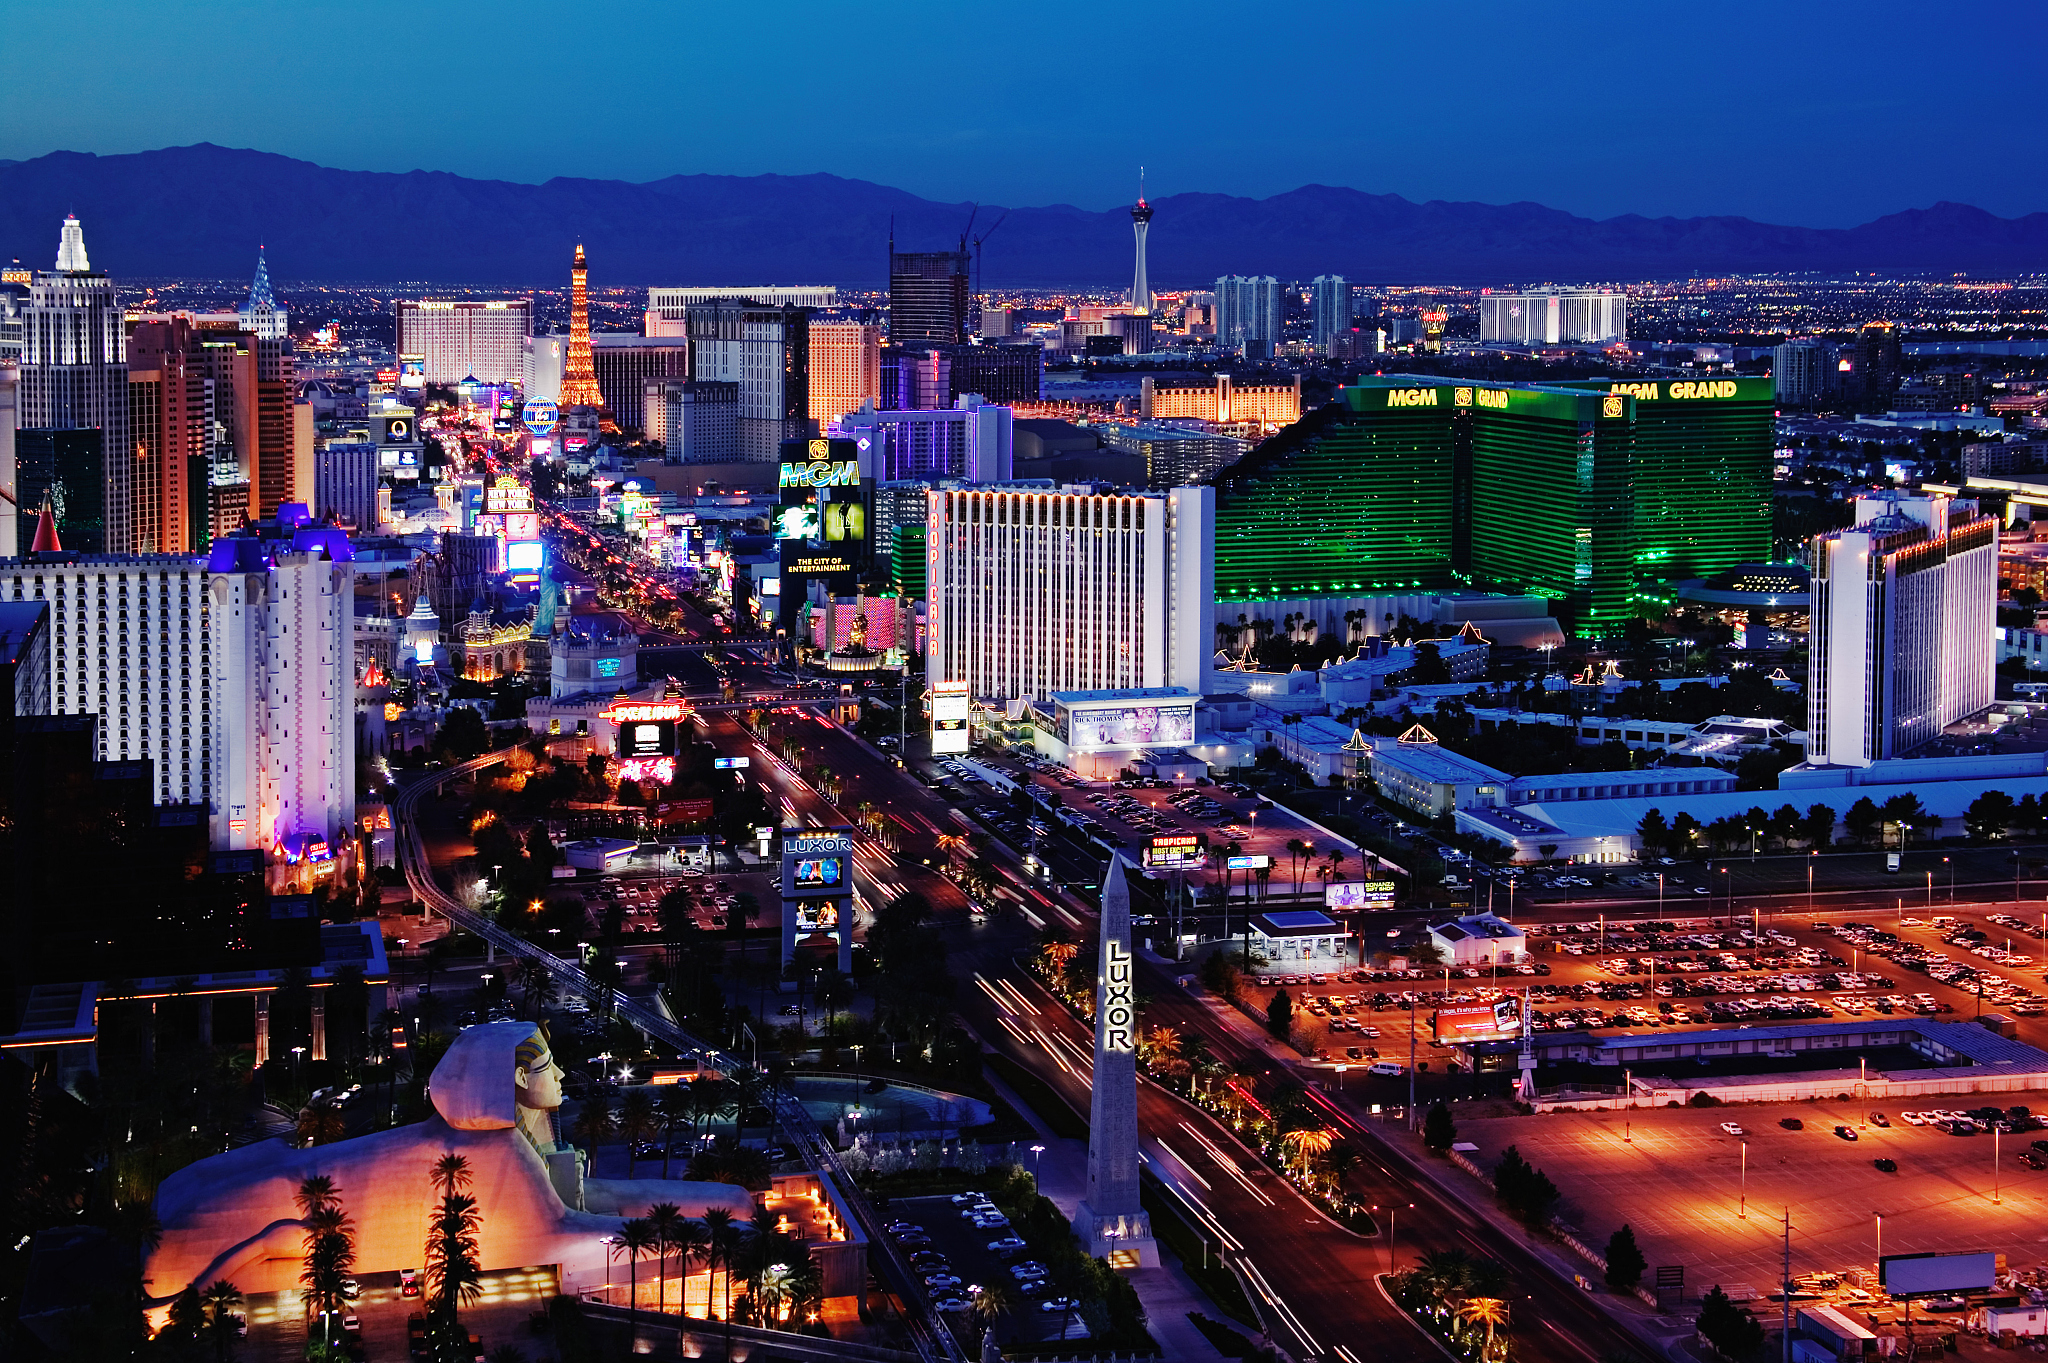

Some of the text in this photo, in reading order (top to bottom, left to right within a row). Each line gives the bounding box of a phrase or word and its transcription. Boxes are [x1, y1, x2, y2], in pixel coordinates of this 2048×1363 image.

[1387, 389, 1438, 407] MGM
[1478, 389, 1509, 409] GRAND
[1611, 381, 1737, 400] MGM GRAND
[779, 460, 861, 488] MGM
[788, 564, 851, 573] ENTERTAINMENT
[929, 494, 939, 656] TROPICANA
[616, 705, 680, 721] EXCALIBUR
[784, 838, 852, 854] LUXOR
[1153, 836, 1197, 846] TROPICANA
[1107, 943, 1133, 1049] LUXOR
